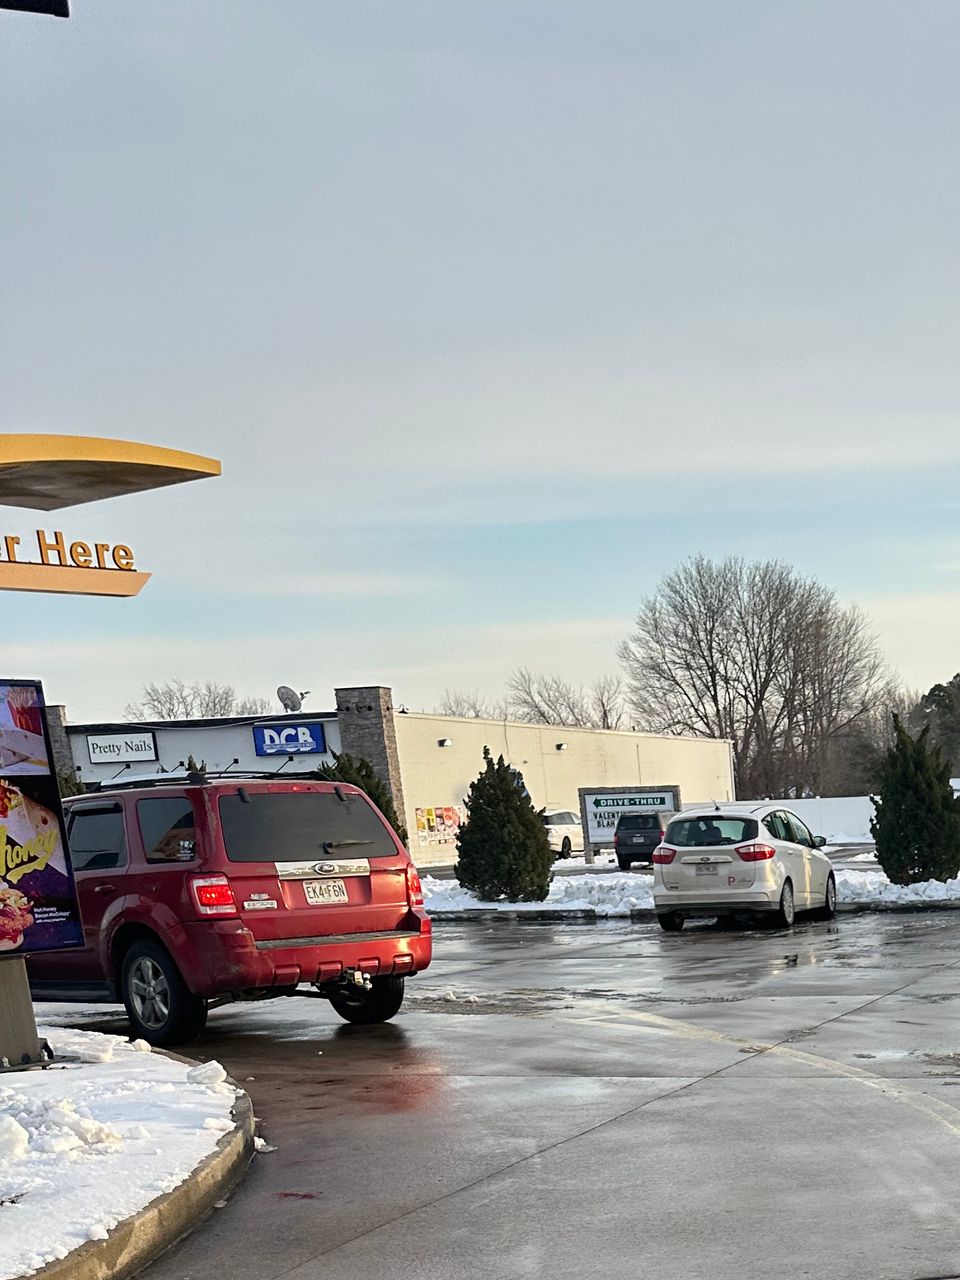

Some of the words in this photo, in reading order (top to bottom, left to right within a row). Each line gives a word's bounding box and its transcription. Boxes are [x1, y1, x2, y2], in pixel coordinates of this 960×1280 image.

[0, 535, 20, 562] r
[36, 530, 135, 570] Here
[91, 742, 121, 756] Pretty
[124, 740, 153, 752] Nails
[600, 797, 661, 806] DRIVE-THRU
[597, 820, 616, 828] BLAH
[727, 875, 736, 886] P
